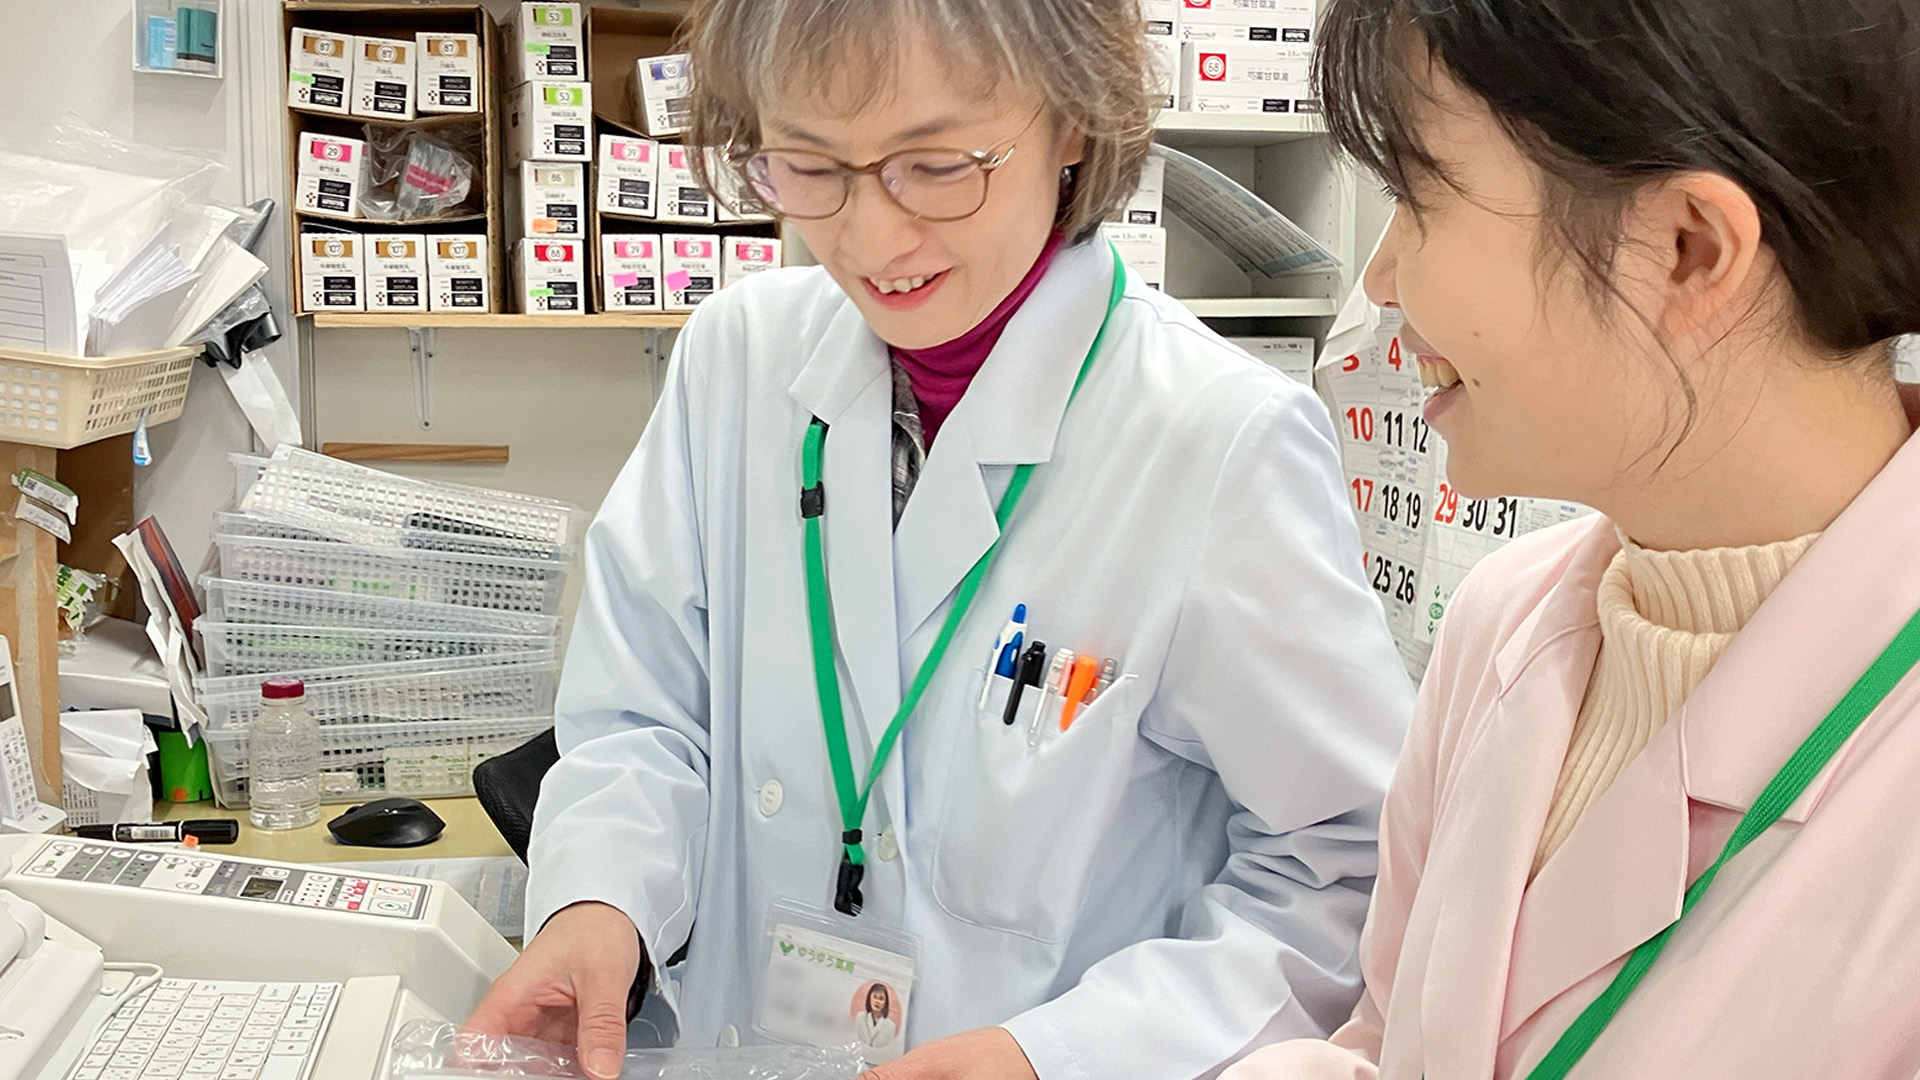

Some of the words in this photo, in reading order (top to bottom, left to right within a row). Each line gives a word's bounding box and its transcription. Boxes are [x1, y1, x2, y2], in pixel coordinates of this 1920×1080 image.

[549, 12, 560, 21] 53
[1208, 62, 1219, 73] 68
[559, 92, 570, 101] 53
[327, 147, 339, 157] 29
[626, 147, 637, 157] 39
[328, 244, 342, 253] 107
[391, 245, 404, 254] 107
[452, 245, 466, 254] 107
[630, 245, 640, 254] 39
[690, 245, 700, 254] 39
[550, 249, 561, 258] 88
[1388, 337, 1402, 372] 4
[1346, 407, 1374, 441] 10
[1384, 411, 1403, 447] 11
[1412, 416, 1429, 453] 12
[1352, 477, 1374, 512] 17
[1382, 484, 1400, 522] 18
[1405, 491, 1422, 529] 19
[1434, 483, 1459, 524] 29
[1463, 499, 1488, 531] 30
[1493, 497, 1518, 538] 31
[1373, 556, 1391, 594] 25
[1395, 565, 1415, 605] 26
